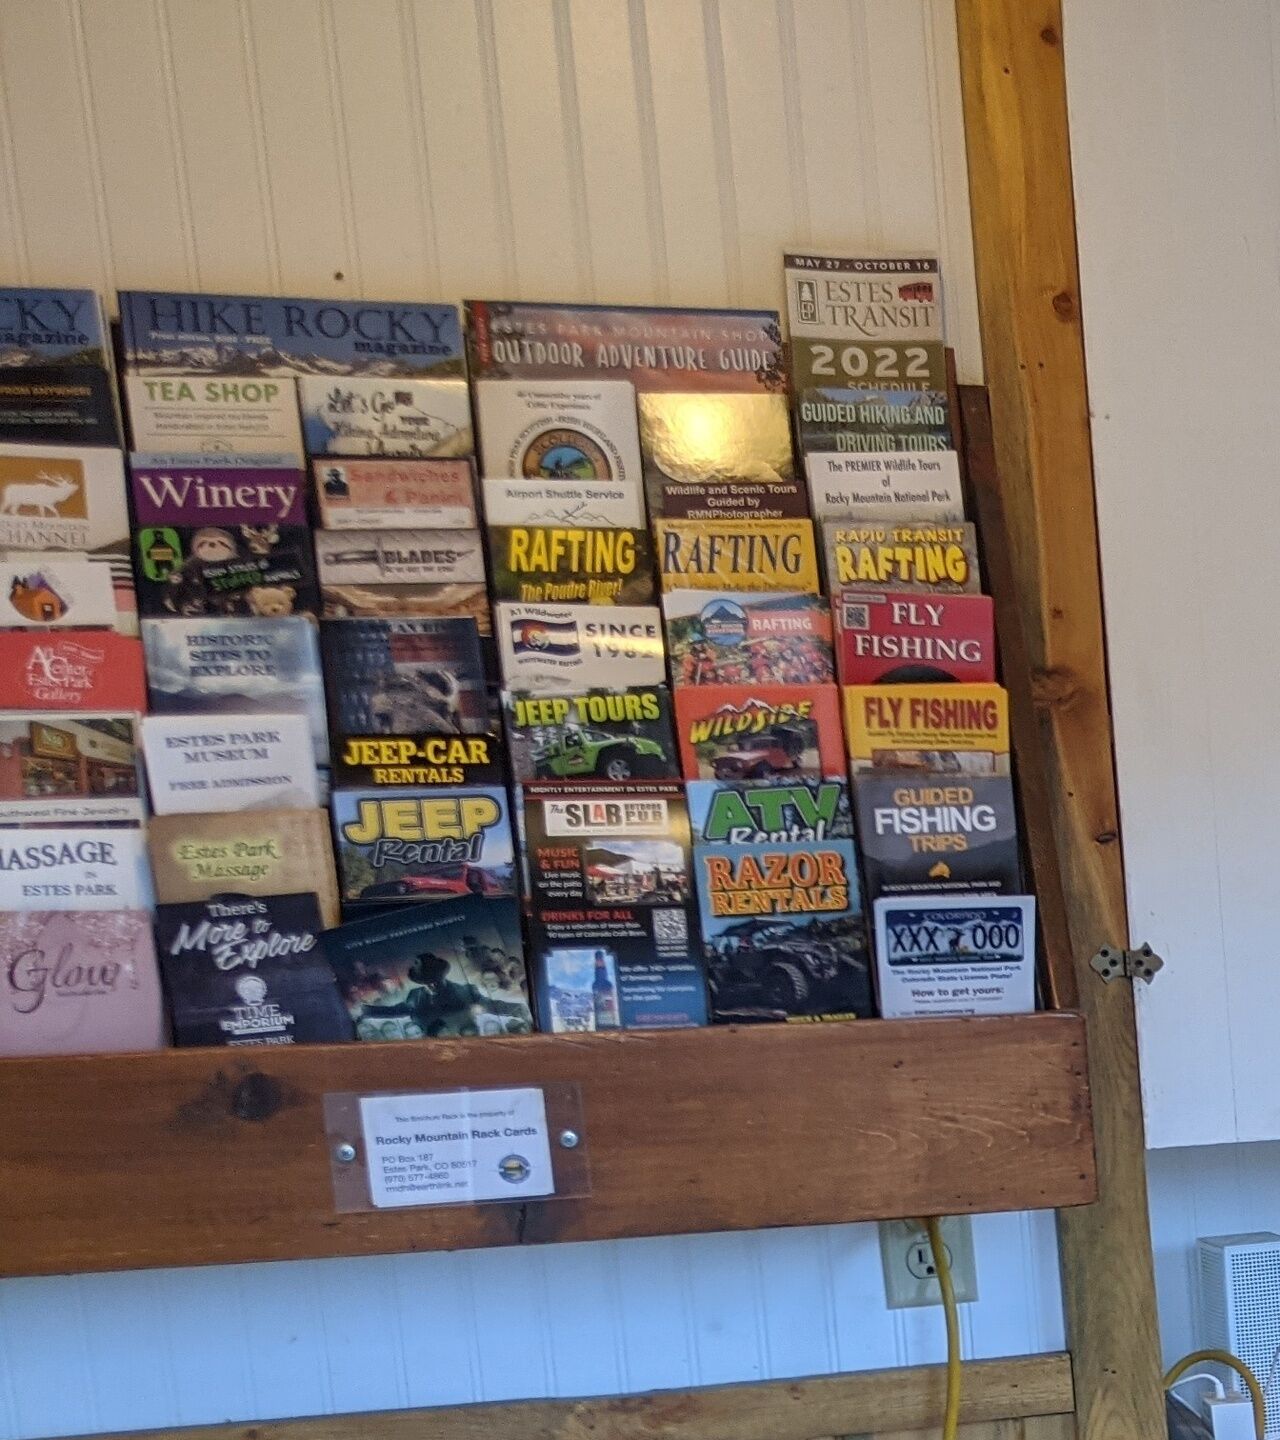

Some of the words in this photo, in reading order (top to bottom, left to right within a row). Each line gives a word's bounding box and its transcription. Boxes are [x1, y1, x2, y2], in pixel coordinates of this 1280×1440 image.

[795, 258, 821, 268] MAY
[827, 259, 840, 269] 27
[855, 260, 911, 271] OCTOBER
[916, 262, 930, 271] 16
[825, 280, 894, 303] ESTES
[150, 299, 266, 336] HIKE
[283, 305, 451, 343] ROCKY
[826, 305, 934, 337] TRANSIT
[354, 341, 453, 357] magazine
[494, 339, 584, 367] OUTDOOR
[600, 342, 706, 371] ADVENTURE
[719, 346, 771, 371] GUIDE
[810, 345, 930, 378] 2022
[144, 380, 196, 402] TEA
[205, 382, 279, 403] SHOP
[801, 402, 856, 424] GUIDED
[860, 404, 910, 426] HIKING
[911, 405, 945, 427] AND
[836, 431, 895, 452] DRIVING
[899, 433, 948, 453] TOURS
[827, 459, 843, 473] The
[845, 459, 882, 474] PREMIER
[883, 458, 915, 473] Wildlife
[916, 459, 941, 472] Tours
[138, 475, 298, 518] Winery
[505, 489, 543, 501] Airport
[545, 488, 583, 500] Shuttle
[585, 489, 625, 500] Service
[666, 484, 706, 496] Wildlife
[707, 484, 730, 495] and
[731, 484, 766, 495] Scenic
[767, 484, 798, 496] Tours
[825, 491, 849, 507] Rocky
[852, 490, 888, 505] Mountain
[890, 490, 924, 504] National
[926, 490, 951, 504] Park
[687, 508, 784, 521] RMNPhotographer
[707, 497, 745, 508] Guided
[746, 497, 761, 510] by
[836, 528, 887, 543] RAPID
[892, 527, 963, 543] TRANSIT
[383, 550, 457, 564] BLADES
[510, 528, 636, 575] RAFTING
[662, 529, 802, 575] RAFTING
[835, 545, 968, 584] RAFTING
[752, 617, 813, 631] RAFTING
[892, 601, 943, 627] FLY
[585, 623, 657, 639] SINCE
[854, 634, 982, 663] FISHING
[191, 664, 277, 677] EXPLORE
[516, 697, 569, 727] JEEP
[574, 693, 660, 723] TOURS
[863, 696, 903, 729] FLY
[909, 697, 999, 731] FISHING
[690, 700, 813, 744] WILDSIDE
[166, 733, 226, 749] ESTES
[229, 731, 281, 745] PARK
[343, 737, 490, 766] JEEP-CAR
[183, 748, 270, 764] MUSEUM
[374, 766, 465, 785] RENTALS
[893, 787, 973, 806] GUIDED
[343, 795, 501, 844] JEEP
[705, 784, 842, 839] ATV
[873, 805, 997, 837] FISHING
[0, 841, 118, 870] ASSAGE
[178, 843, 229, 861] Estes
[233, 840, 282, 860] Park
[372, 831, 484, 868] Rental
[907, 834, 968, 854] TRIPS
[193, 863, 270, 881] Massage
[704, 851, 849, 891] RAZOR
[22, 884, 71, 897] ESTES
[75, 884, 118, 897] PARK
[710, 886, 849, 918] RENTALS
[208, 902, 269, 918] There's
[889, 926, 941, 953] XXX
[972, 924, 1020, 950] 000
[211, 932, 317, 972] Explore
[8, 942, 121, 1014] Glow
[231, 1003, 281, 1018] TIME
[221, 1014, 295, 1032] EMPORIUM
[376, 1135, 412, 1147] Rocky
[415, 1132, 468, 1144] Mountain
[471, 1128, 502, 1140] Rack
[504, 1126, 538, 1138] Cards
